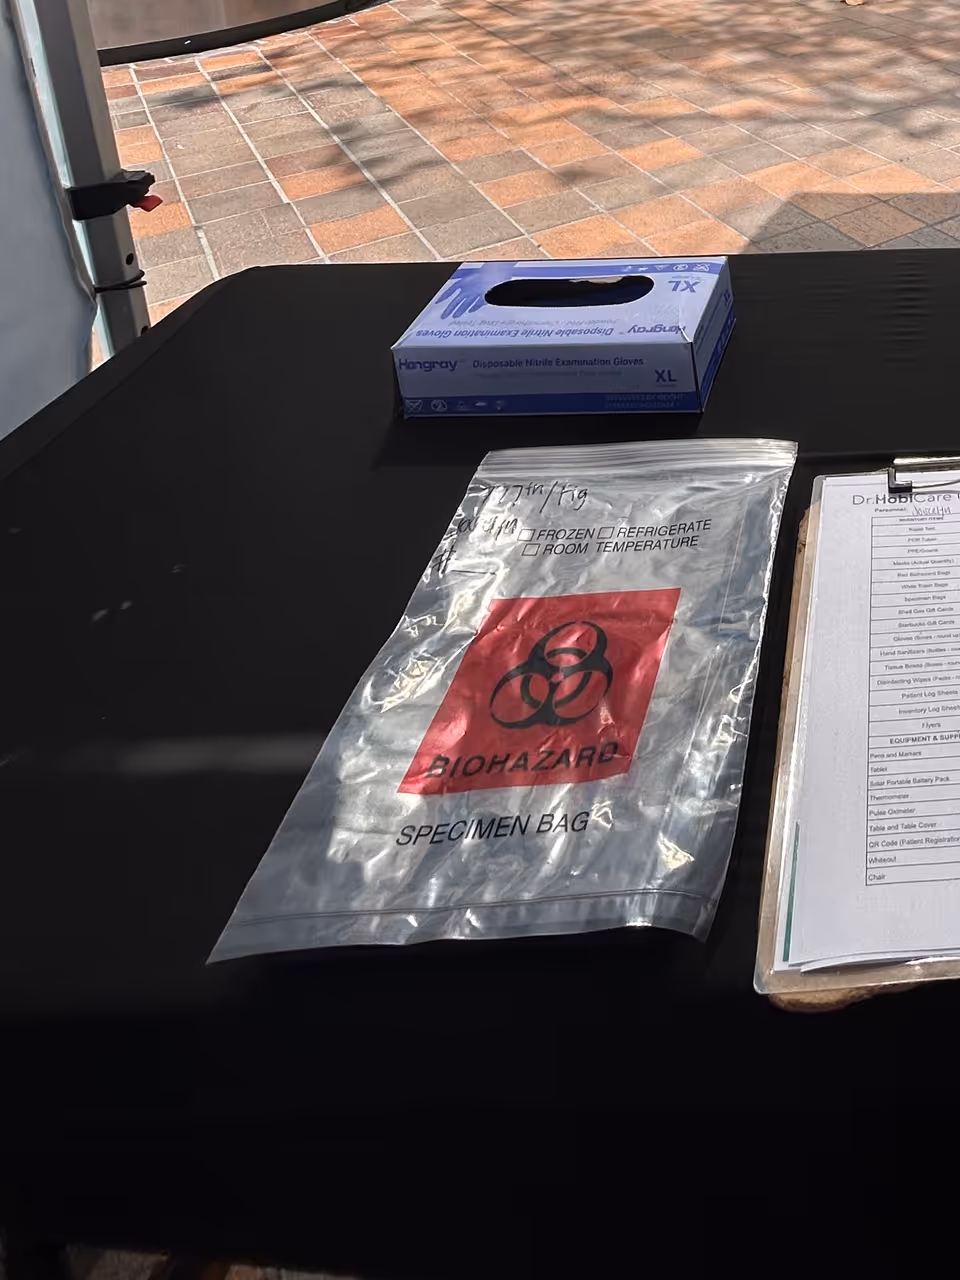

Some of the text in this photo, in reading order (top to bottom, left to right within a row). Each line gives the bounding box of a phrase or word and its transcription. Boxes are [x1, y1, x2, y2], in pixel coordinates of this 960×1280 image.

[668, 280, 701, 293] XL
[415, 329, 451, 338] Gloves
[454, 329, 519, 338] Examination
[521, 329, 554, 337] Nitrile
[555, 327, 614, 337] Disposable
[473, 359, 523, 369] Disposable
[525, 358, 553, 367] Nitrile
[555, 357, 611, 367] Examination
[613, 356, 644, 366] Gloves
[655, 369, 678, 383] XL
[536, 528, 596, 540] FROZEN
[617, 519, 712, 539] REFRIGERATE
[542, 535, 700, 556] ROOM TEMPERATURE
[889, 735, 931, 744] EQUIPMENT
[424, 741, 620, 778] BIOHAZARD
[396, 811, 591, 846] SPECIMEN BAG
[900, 838, 924, 846] (Patient
[869, 856, 897, 864] Whiteout
